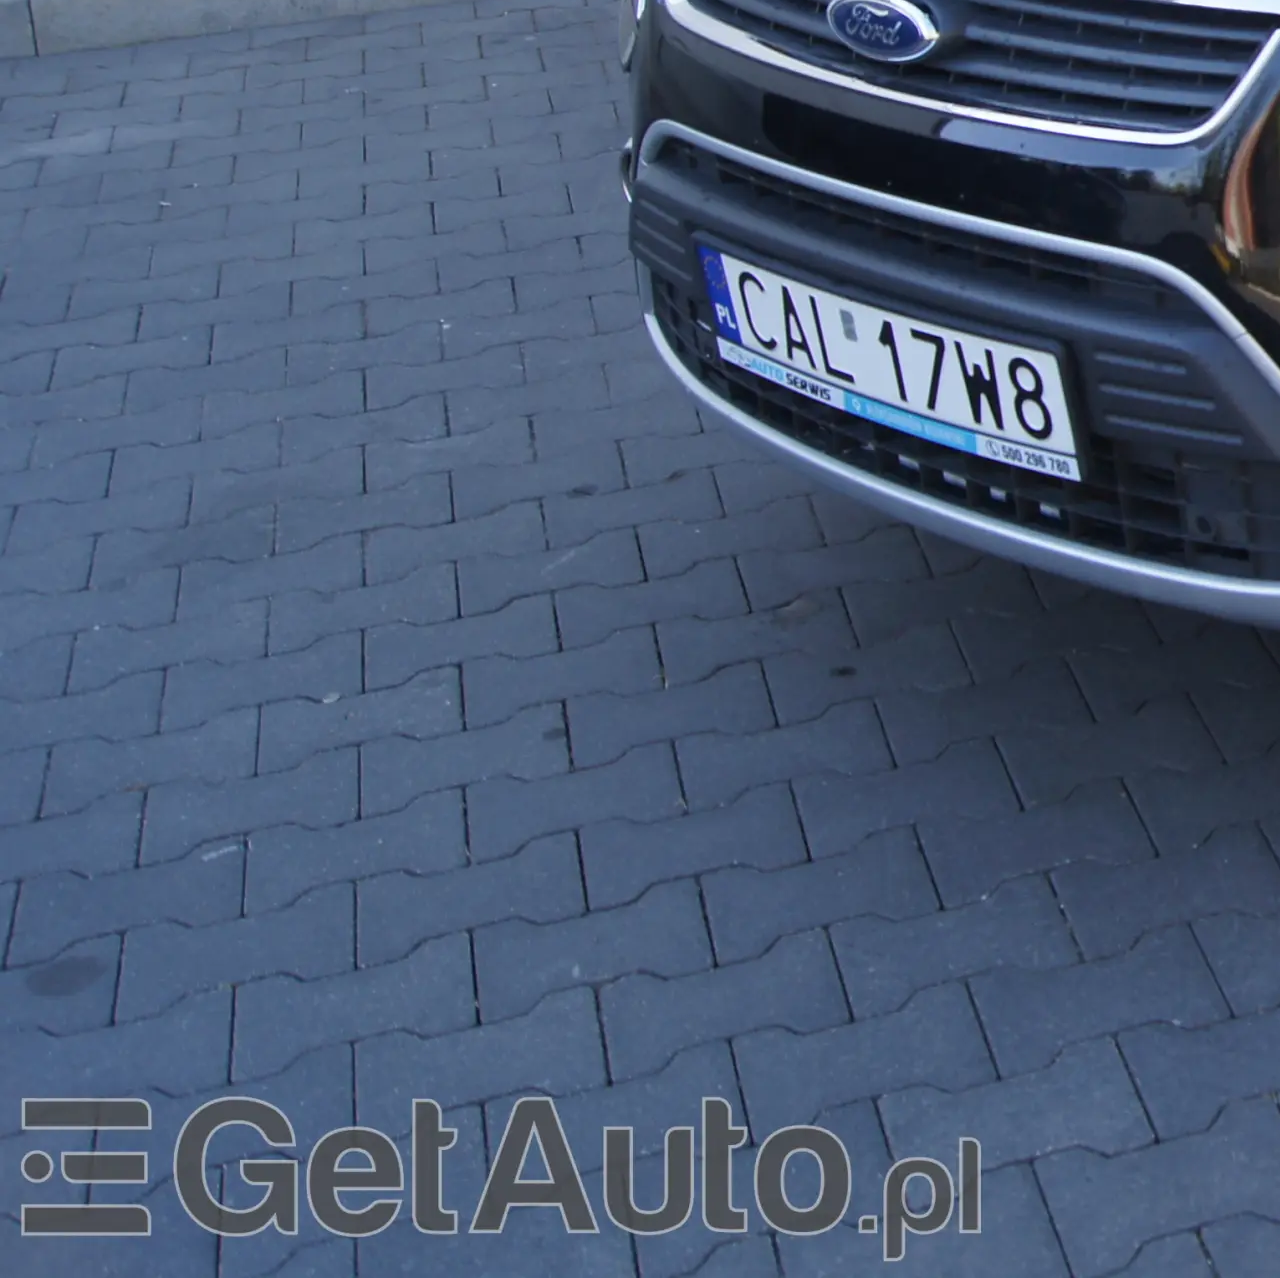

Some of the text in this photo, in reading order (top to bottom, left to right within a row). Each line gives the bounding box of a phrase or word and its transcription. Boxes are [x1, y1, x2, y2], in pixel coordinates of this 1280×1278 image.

[845, 3, 902, 45] Ford
[714, 302, 736, 330] PL
[738, 271, 1053, 440] CAL 17W8
[785, 371, 832, 401] SERWIS
